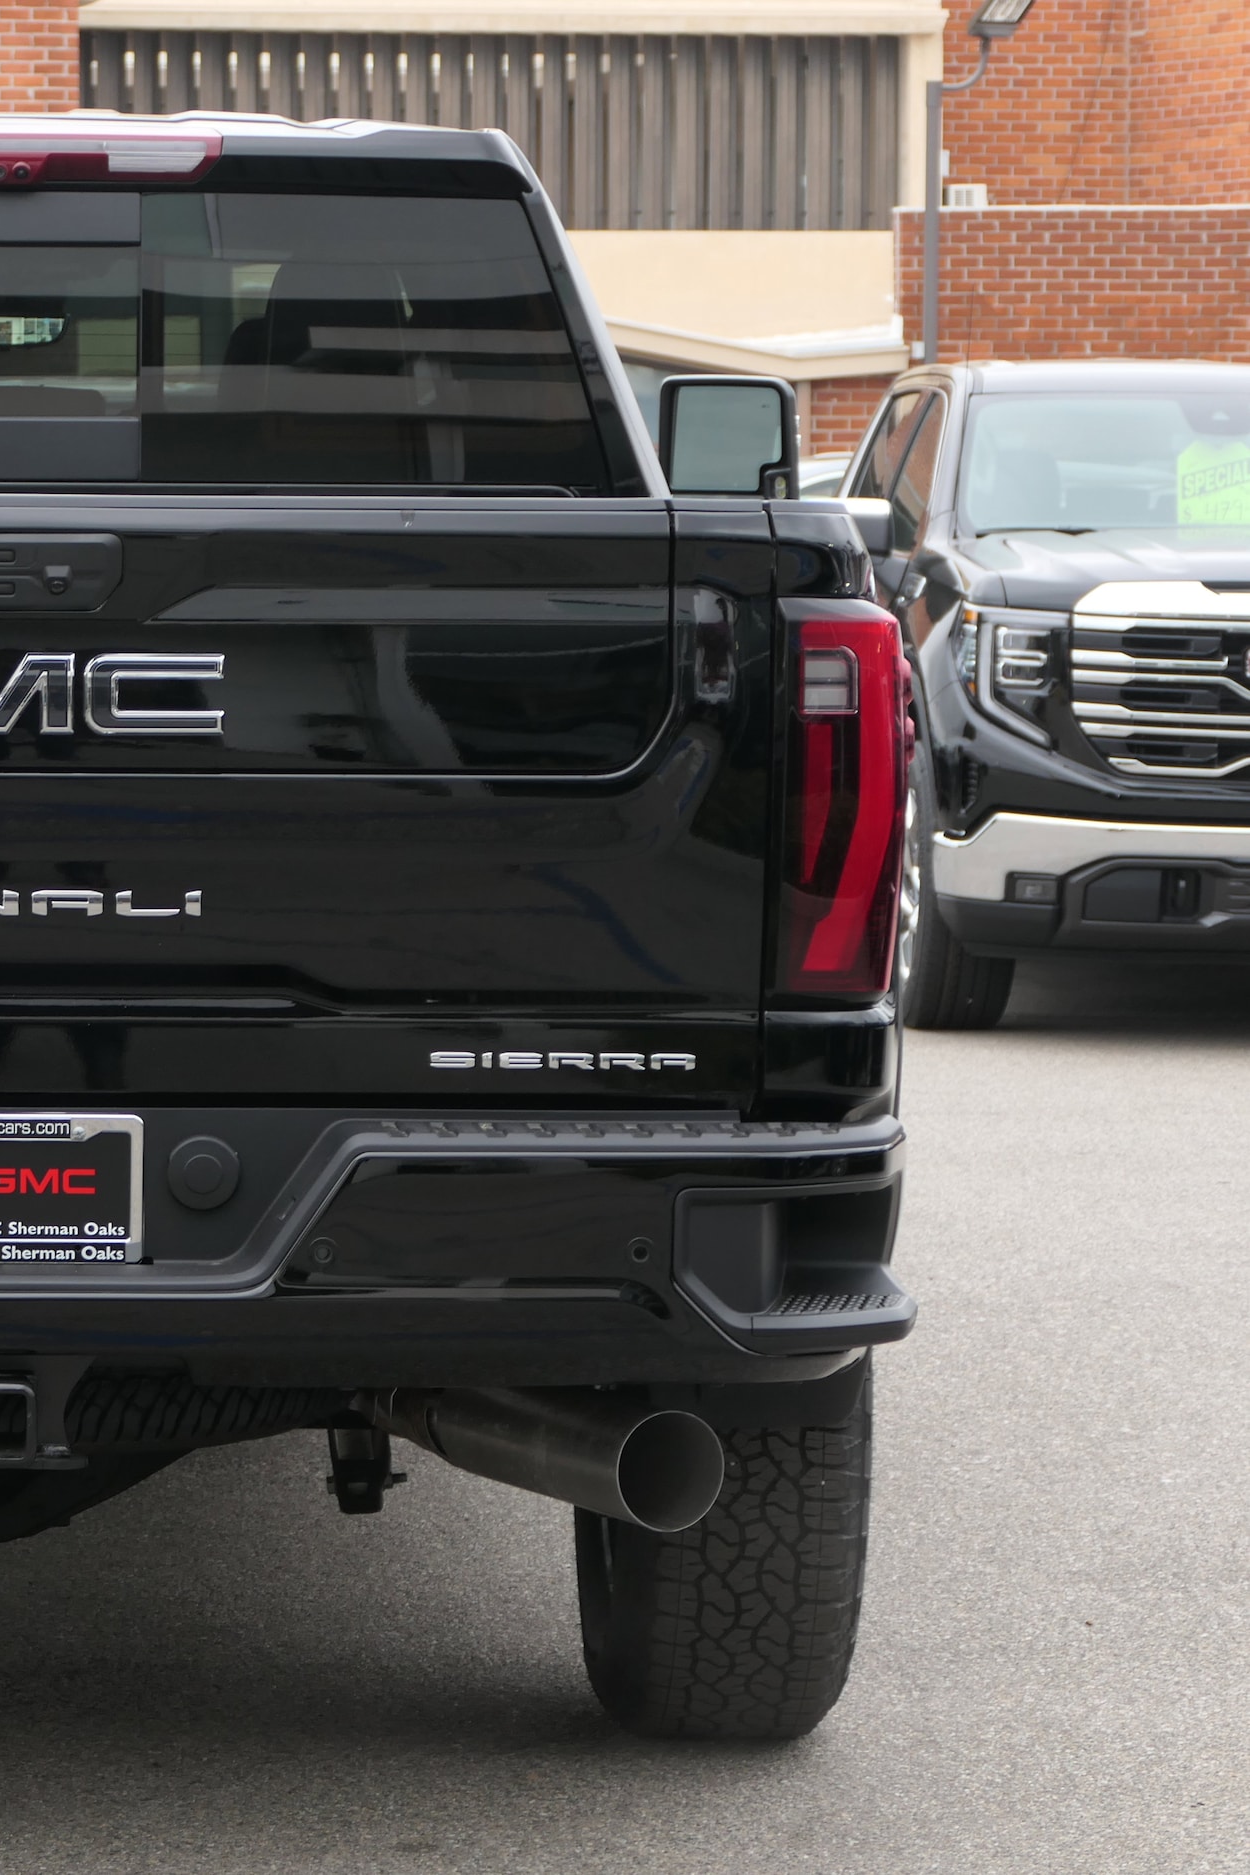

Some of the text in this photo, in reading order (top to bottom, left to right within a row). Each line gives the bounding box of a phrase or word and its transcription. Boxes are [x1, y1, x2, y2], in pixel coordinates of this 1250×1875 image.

[1184, 461, 1250, 496] SPECIAL
[430, 1051, 696, 1071] SIERRA
[8, 1222, 79, 1236] Sherman
[84, 1222, 125, 1236] Oaks
[1, 1246, 76, 1260] Sherman
[81, 1246, 125, 1260] Oaks
